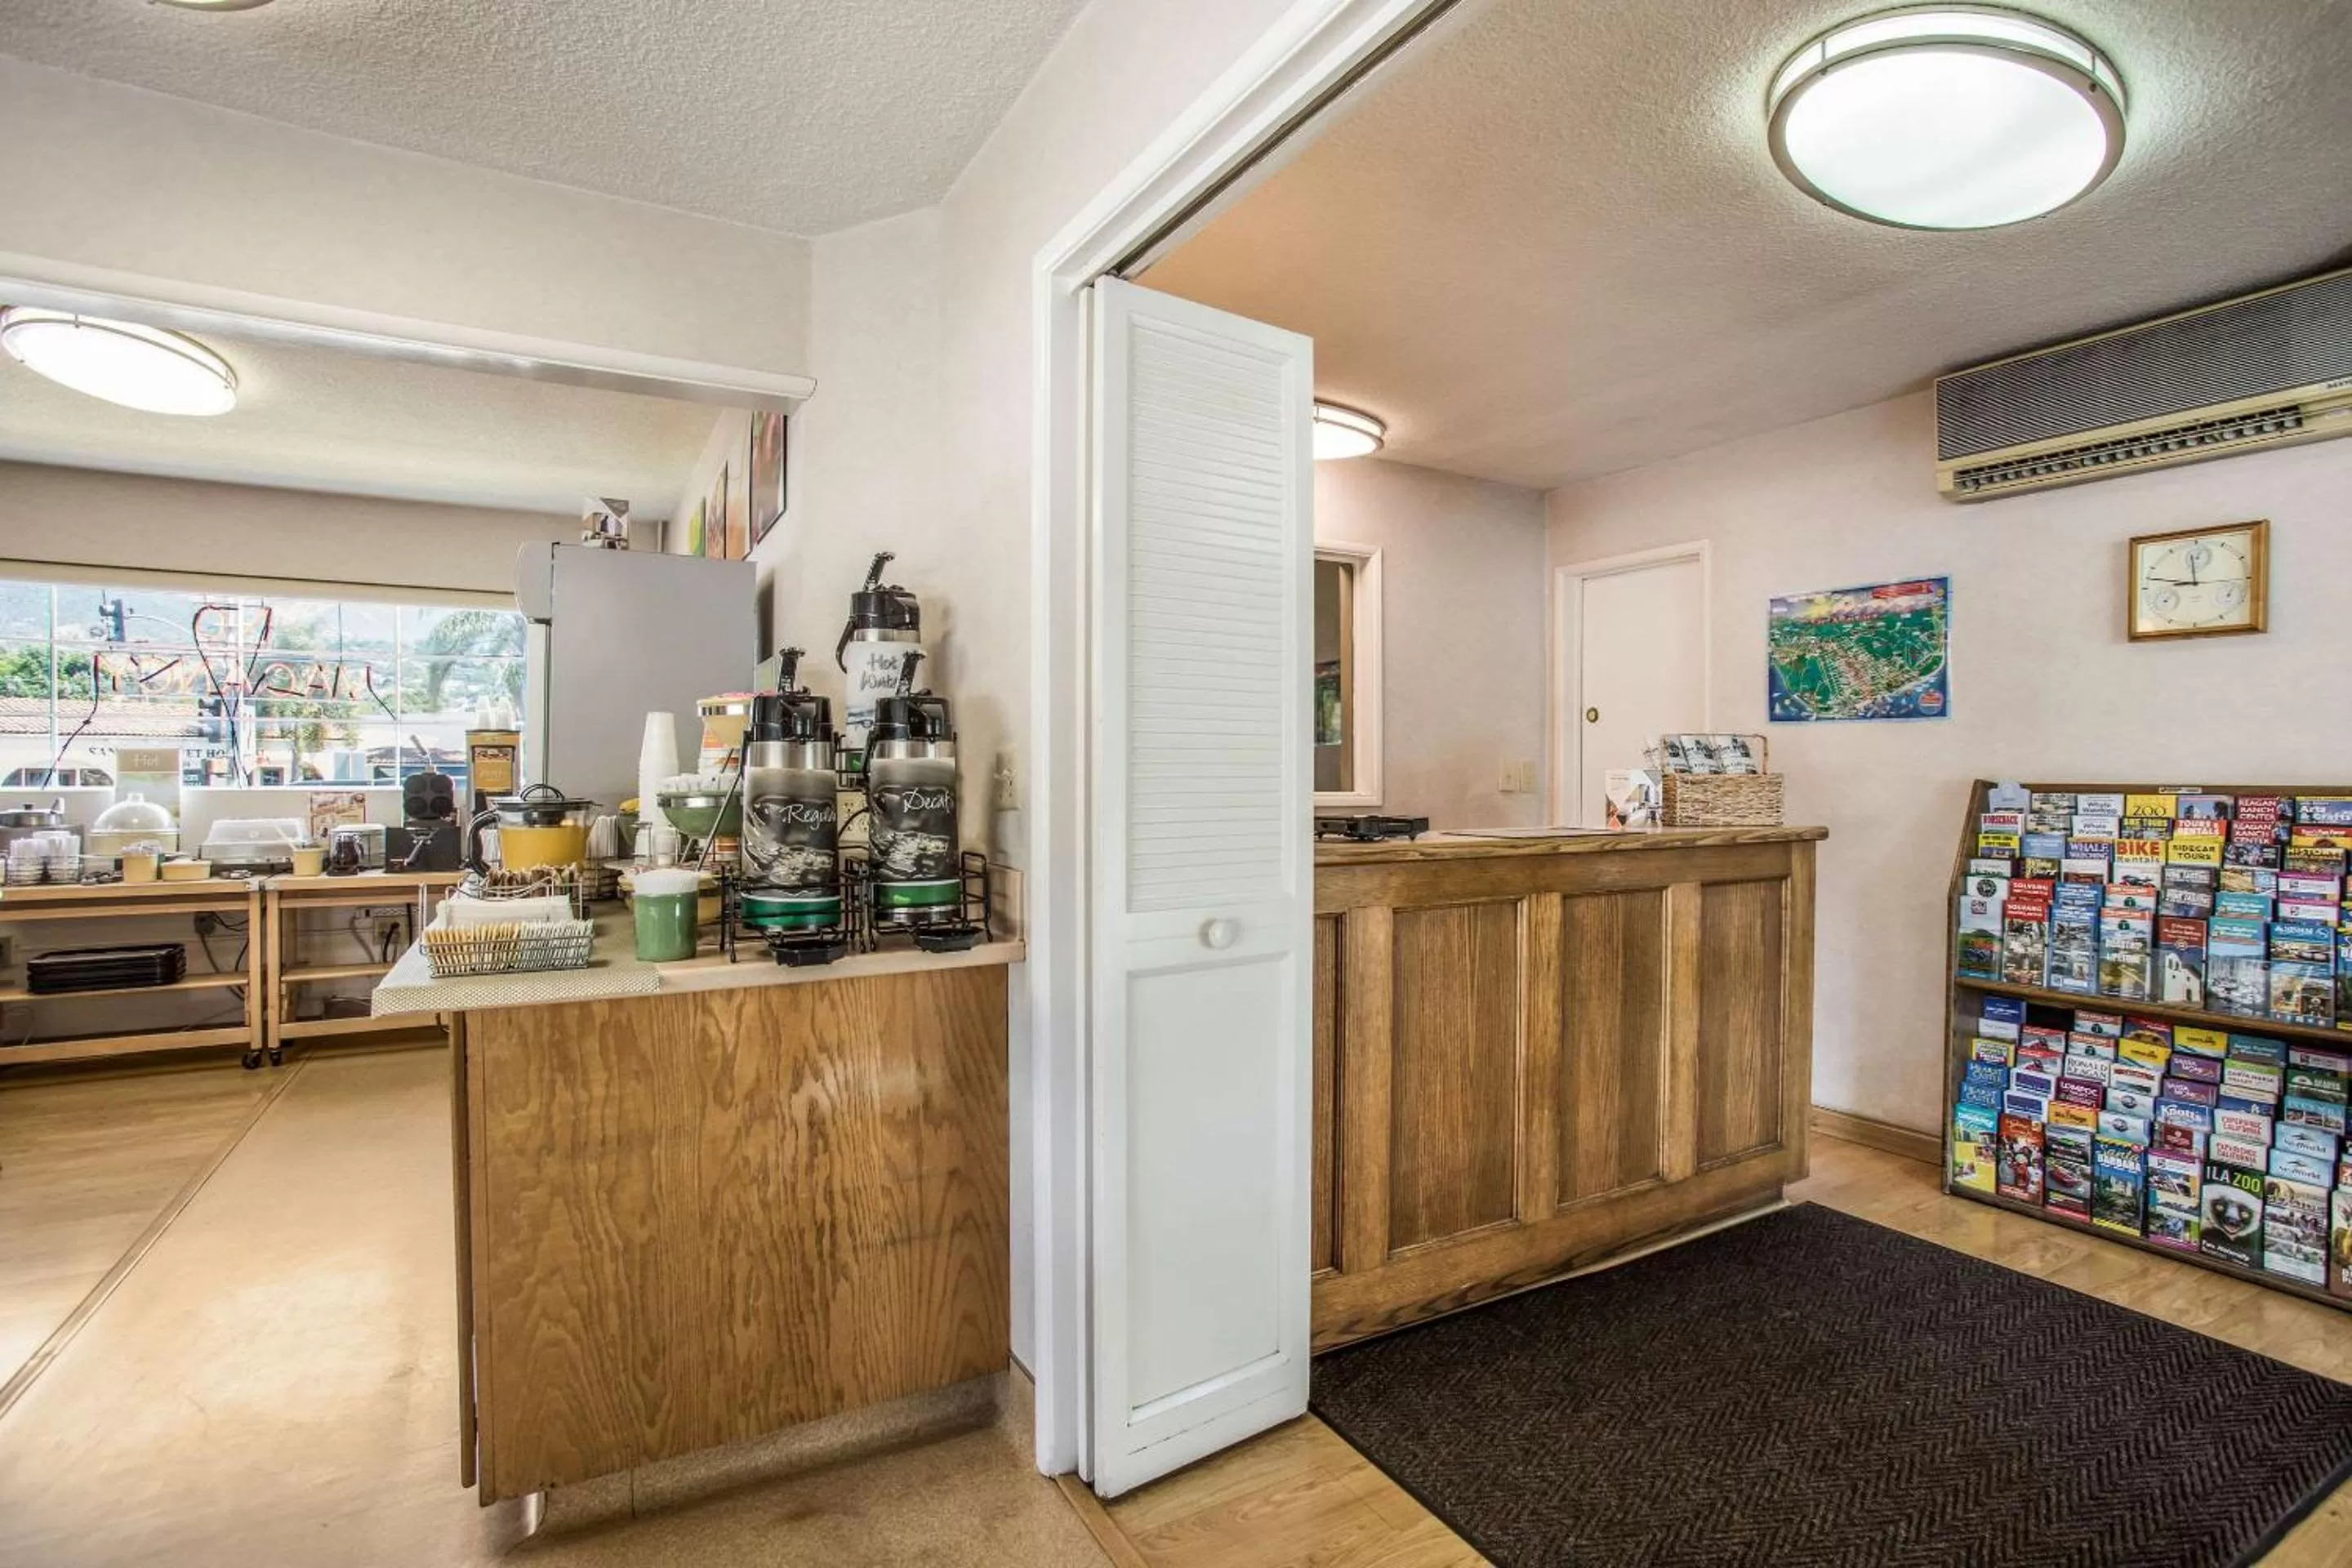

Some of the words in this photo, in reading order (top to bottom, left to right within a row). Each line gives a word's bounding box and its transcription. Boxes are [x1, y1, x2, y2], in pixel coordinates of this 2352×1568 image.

[866, 653, 898, 670] Hot
[860, 670, 898, 690] Wate
[902, 788, 953, 813] Decaf
[2132, 805, 2167, 817] ZOO
[2116, 841, 2161, 856] BIKE
[2172, 844, 2216, 853] SIDECAR
[2117, 855, 2160, 864] Rentals
[2177, 852, 2212, 861] TOURS
[2233, 1172, 2261, 1192] ZOO
